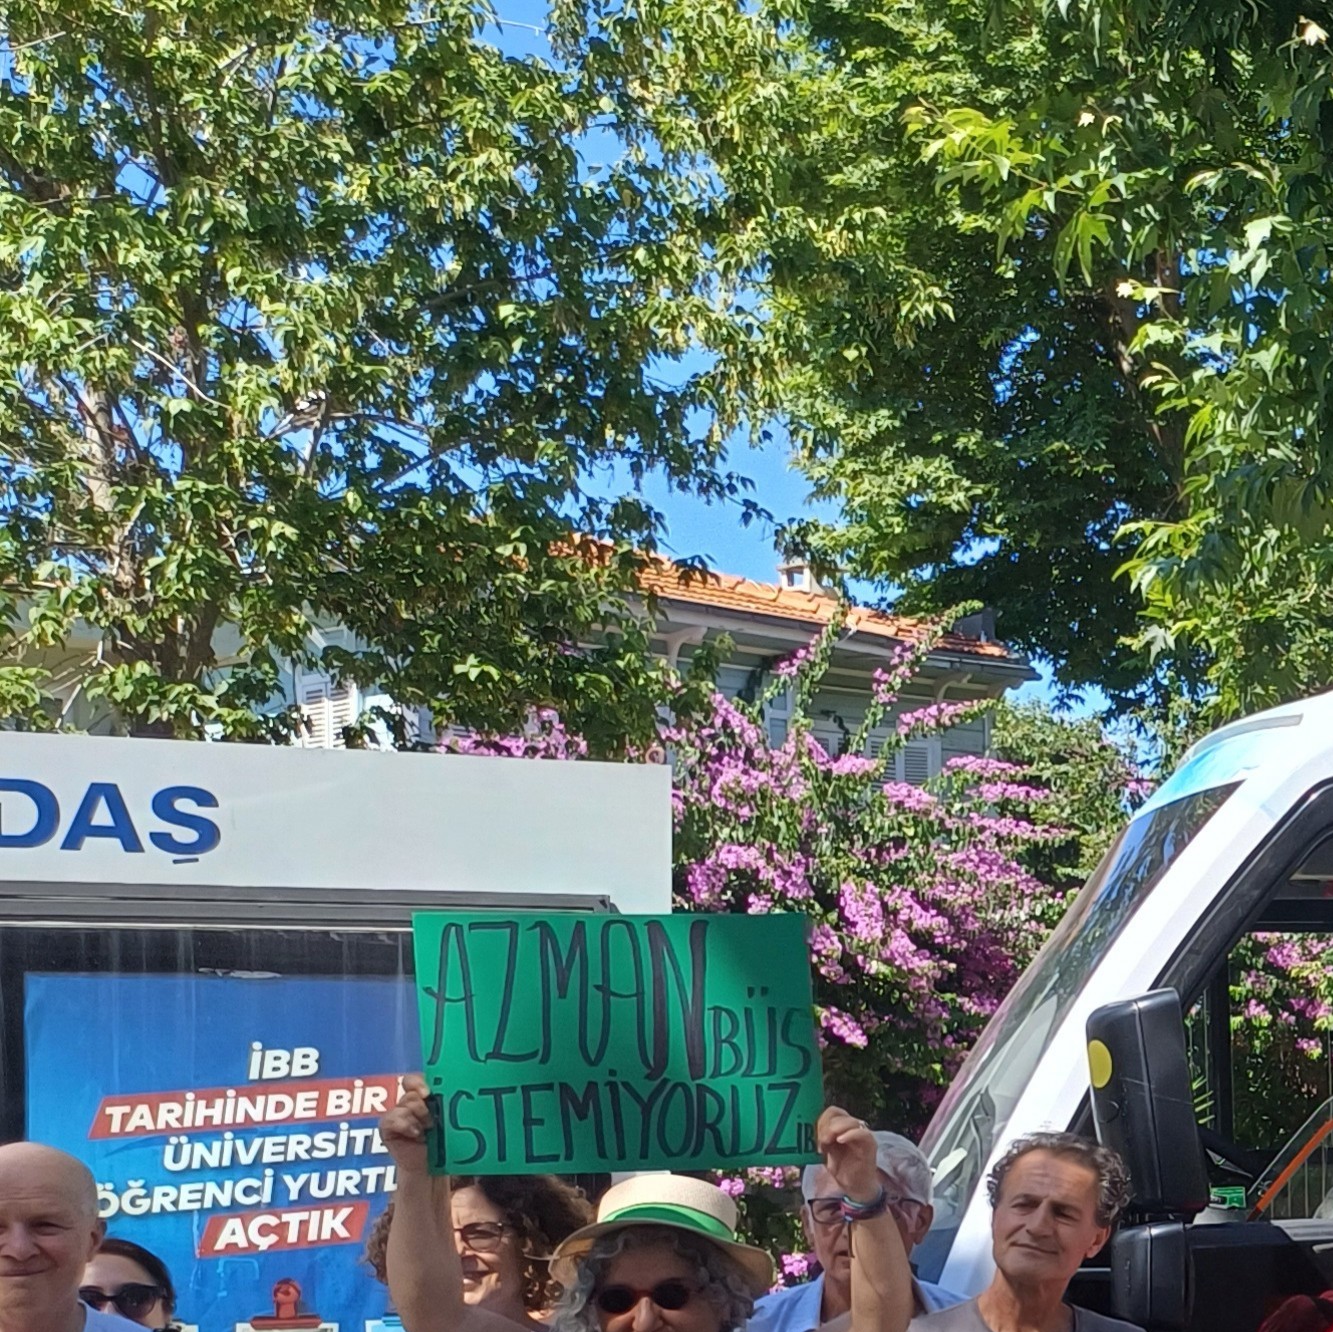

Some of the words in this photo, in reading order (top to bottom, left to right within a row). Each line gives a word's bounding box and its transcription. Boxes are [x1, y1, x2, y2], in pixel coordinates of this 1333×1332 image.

[248, 1041, 319, 1081] İBB
[105, 1089, 320, 1134] TARİHİNDE
[326, 1079, 388, 1117] BİR
[97, 1168, 274, 1218] ÖĞRENCİ
[282, 1166, 398, 1200] YURTL
[214, 1207, 354, 1251] AÇTIK
